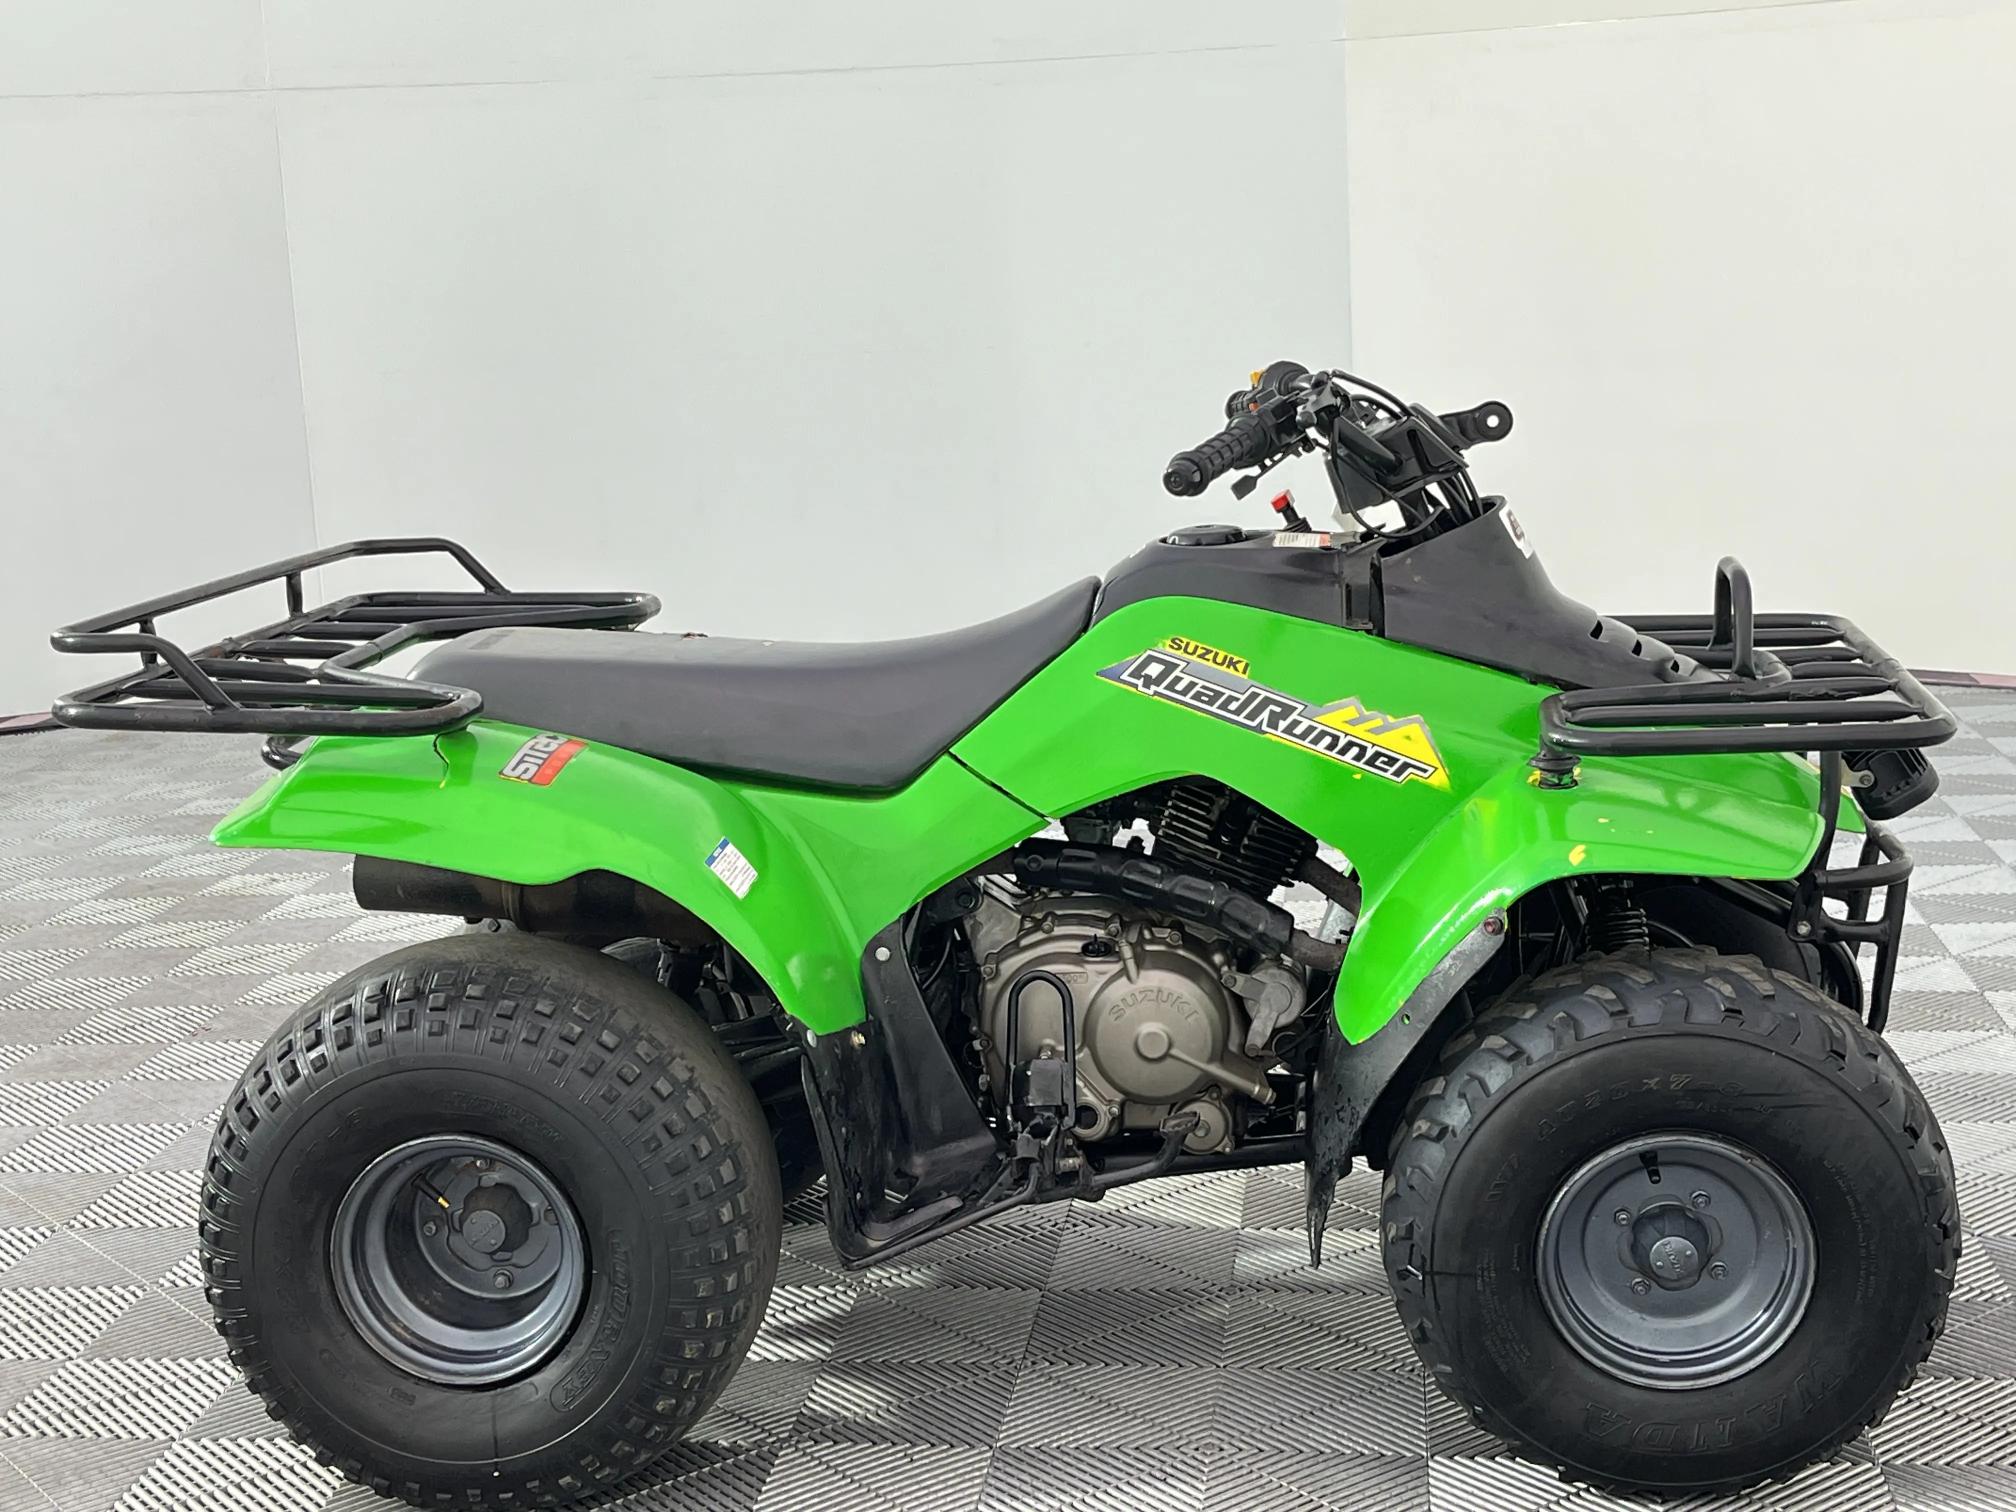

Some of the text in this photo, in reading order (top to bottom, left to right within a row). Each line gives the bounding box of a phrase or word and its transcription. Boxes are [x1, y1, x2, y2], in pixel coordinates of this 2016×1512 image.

[1168, 636, 1250, 676] SUZUKI
[1124, 654, 1433, 781] QuadRunner
[1108, 987, 1200, 1022] SUZUKI
[1585, 1360, 1842, 1451] WANDA
